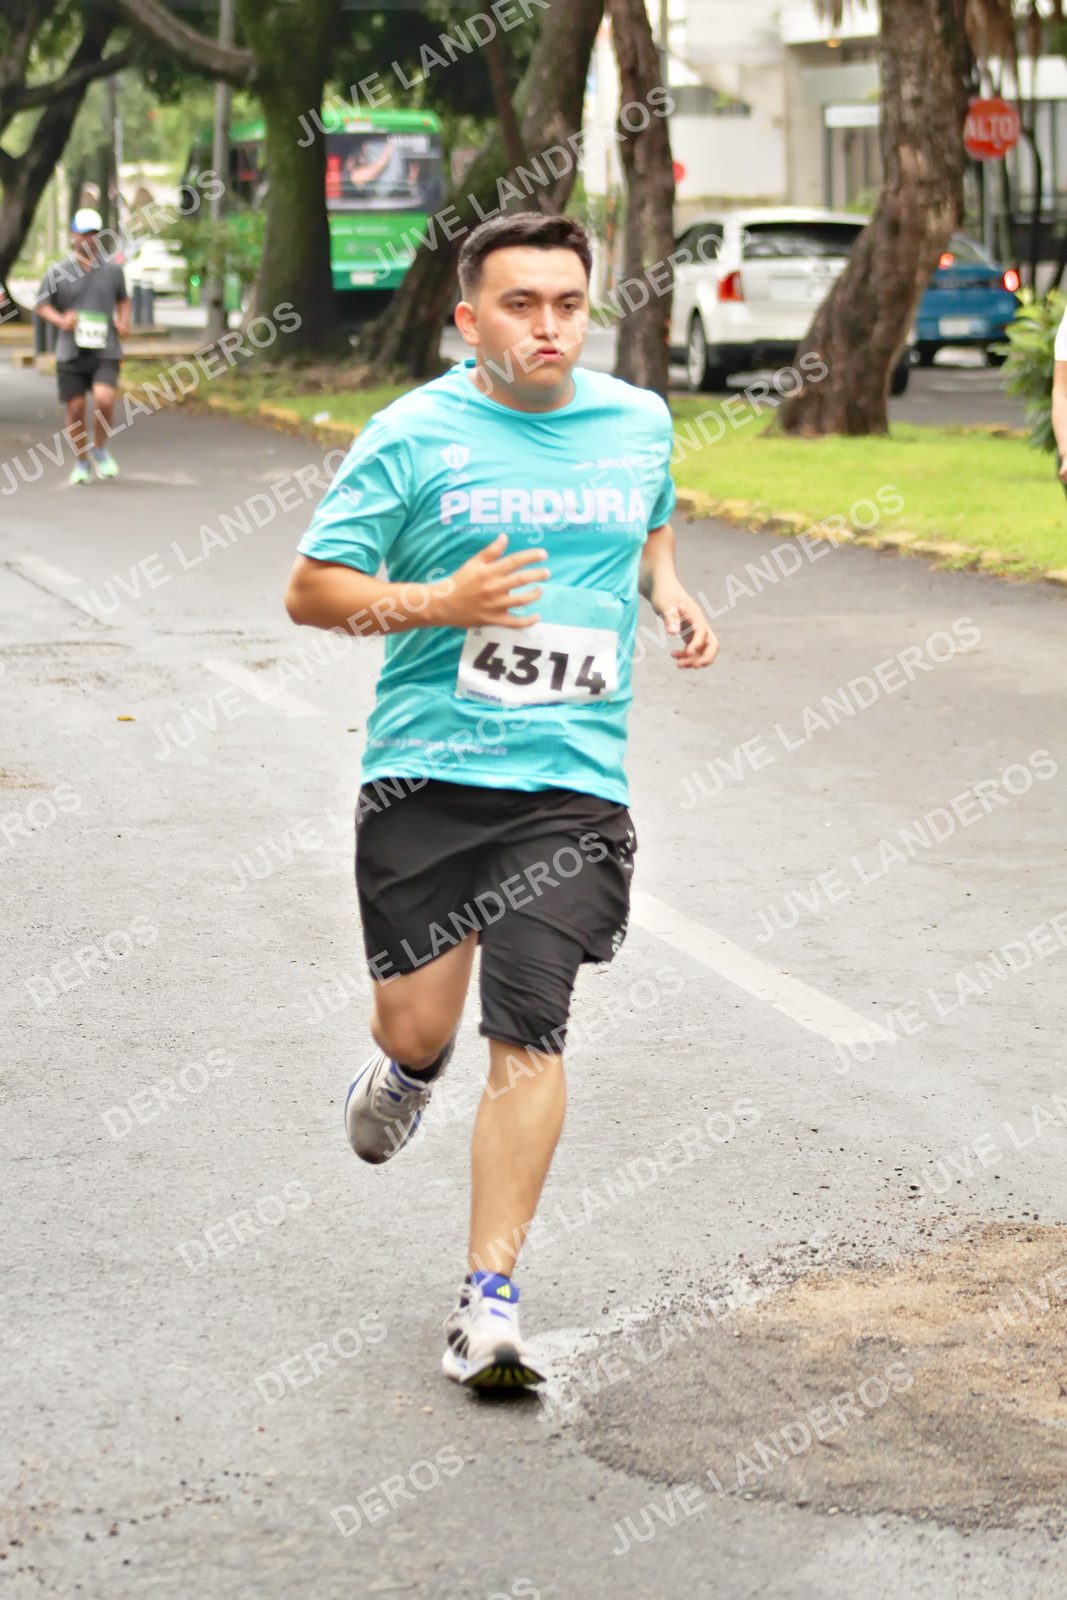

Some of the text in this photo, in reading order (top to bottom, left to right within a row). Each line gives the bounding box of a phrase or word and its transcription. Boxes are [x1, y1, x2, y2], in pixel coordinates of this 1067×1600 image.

[964, 115, 1013, 141] ALTO
[439, 488, 647, 526] PERDURA
[473, 641, 606, 696] 4314
